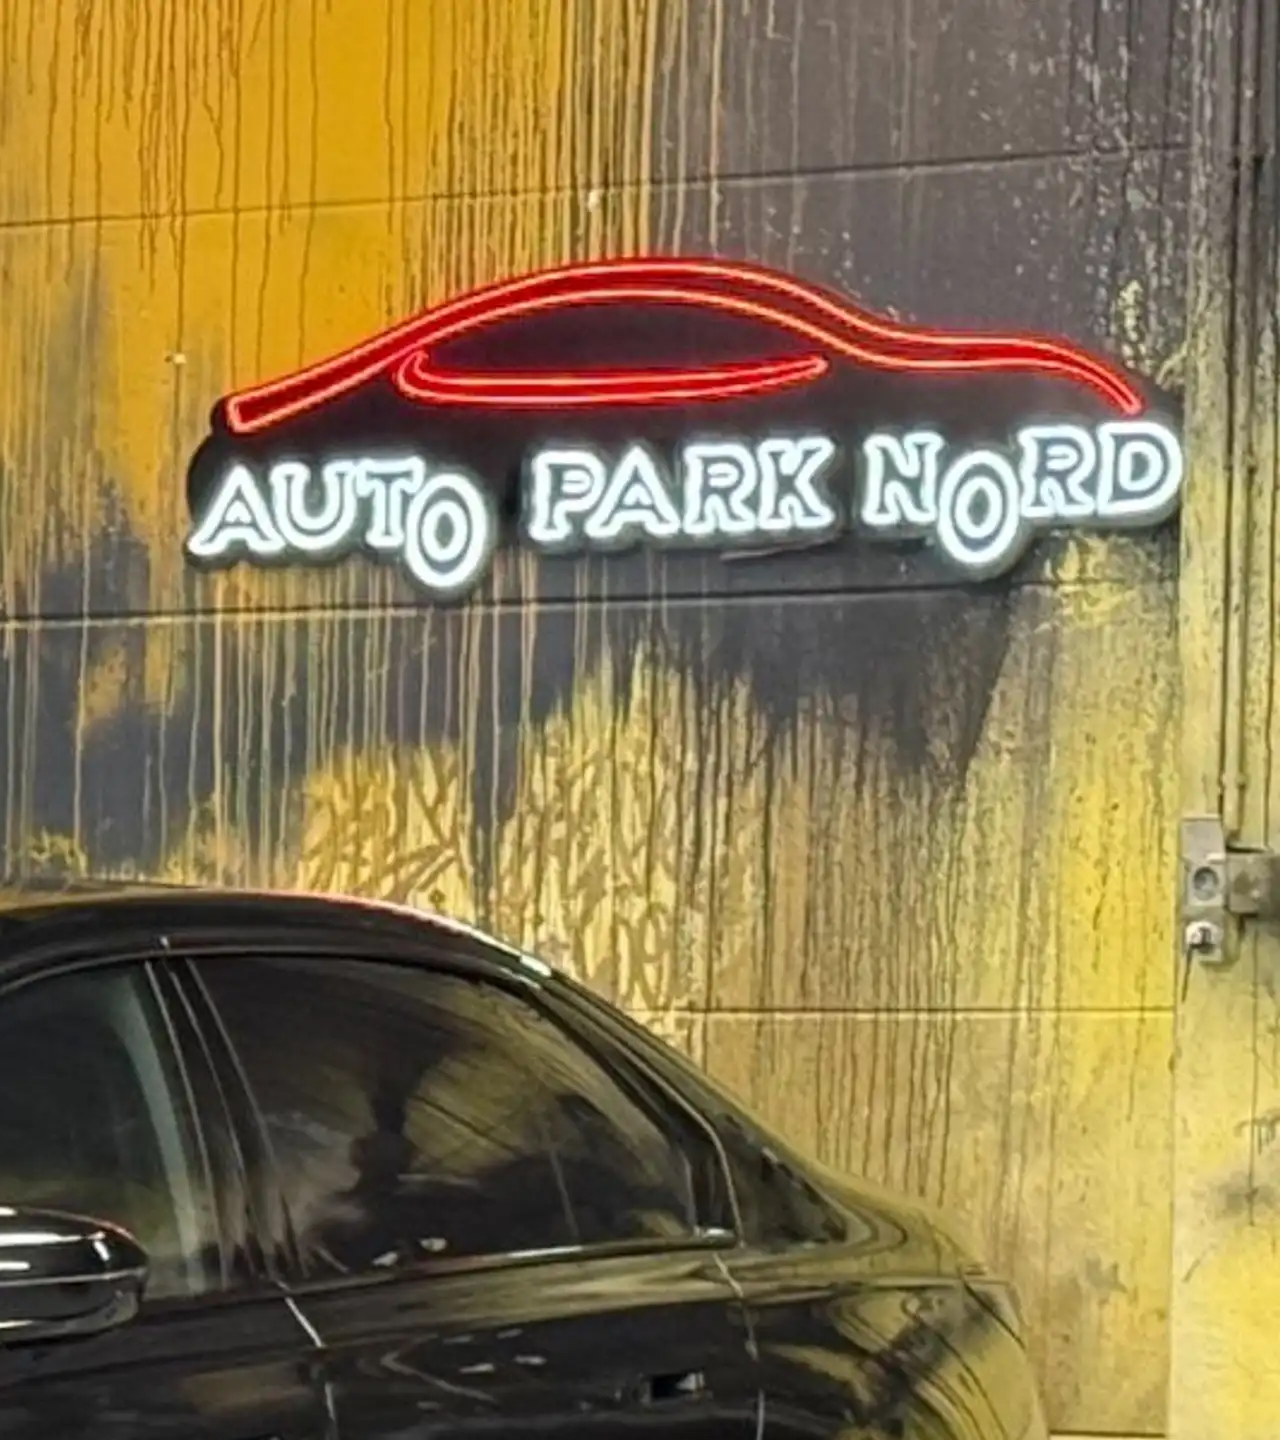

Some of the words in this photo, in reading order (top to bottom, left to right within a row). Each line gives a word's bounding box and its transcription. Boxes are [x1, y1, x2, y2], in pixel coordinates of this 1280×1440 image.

[186, 450, 492, 590] AUTO
[530, 434, 836, 546] PARK
[860, 418, 1186, 568] NORD
